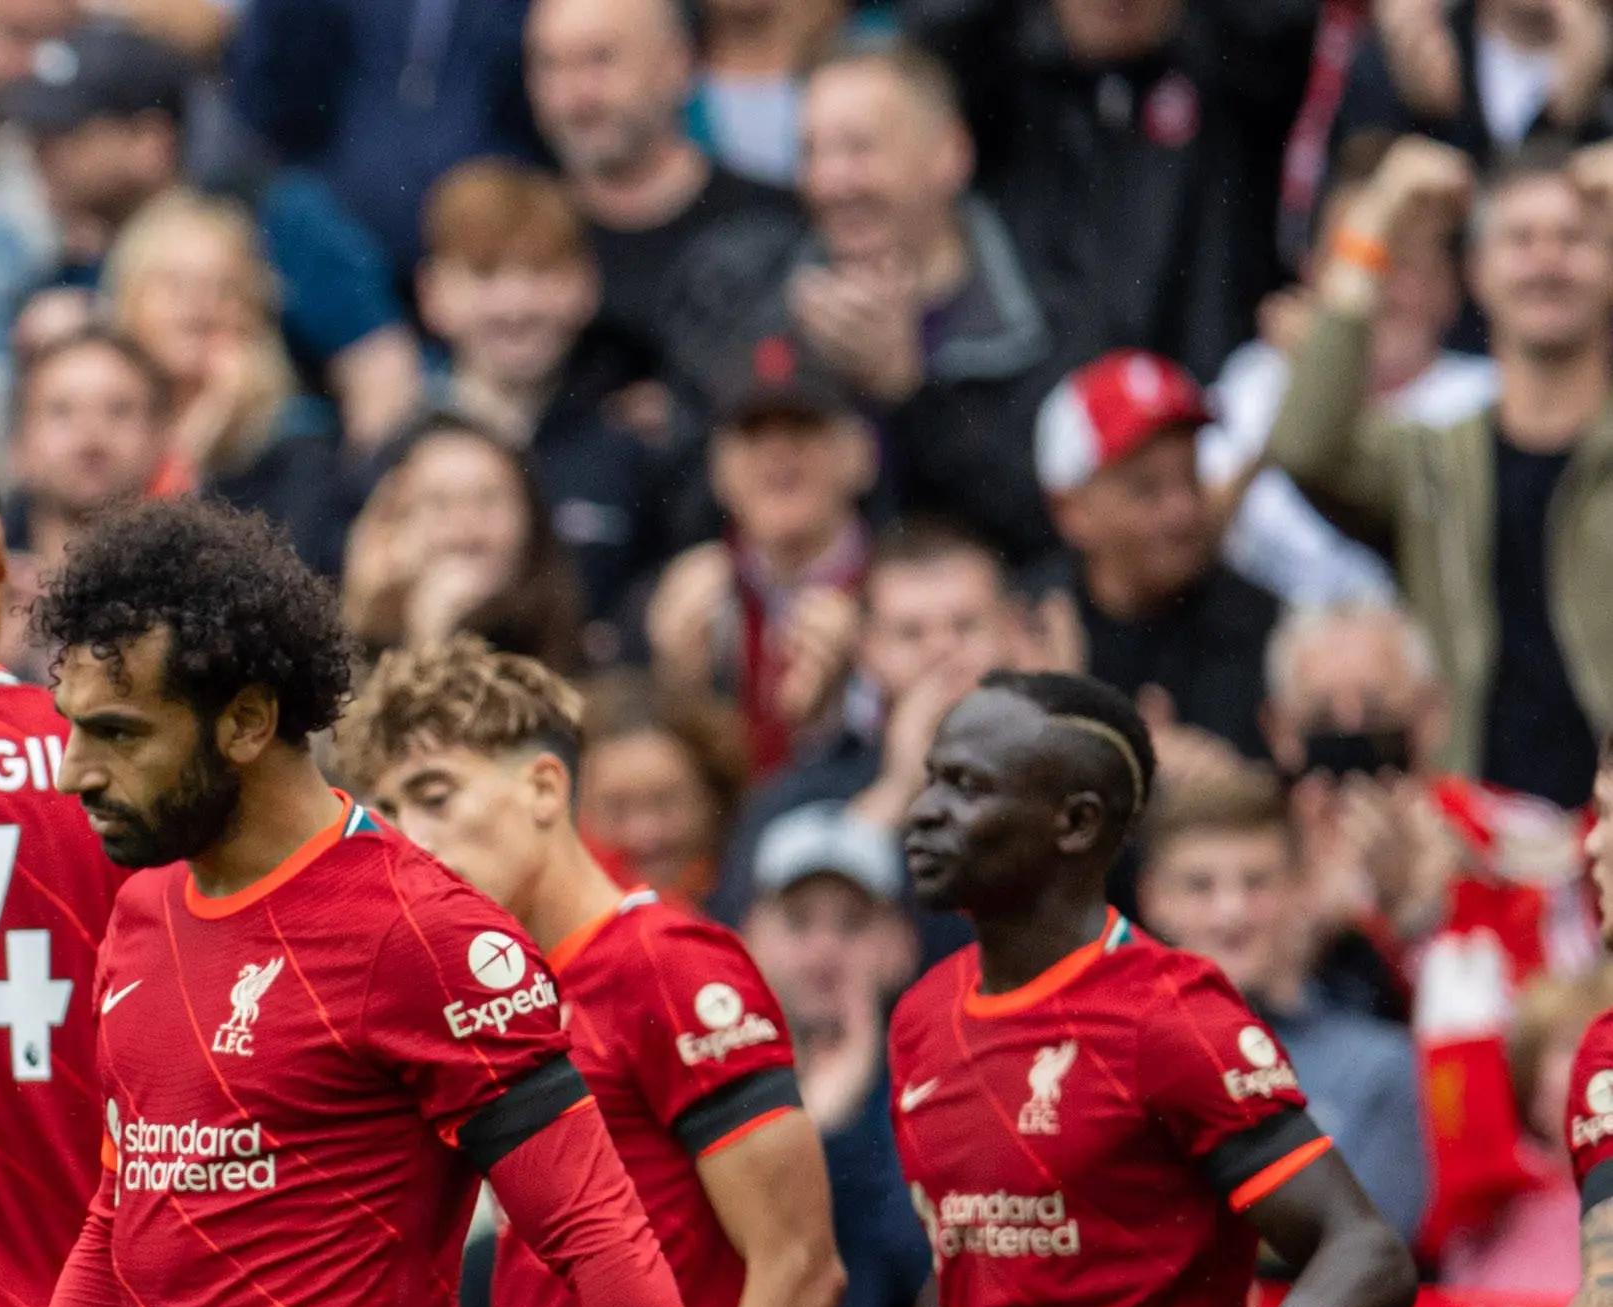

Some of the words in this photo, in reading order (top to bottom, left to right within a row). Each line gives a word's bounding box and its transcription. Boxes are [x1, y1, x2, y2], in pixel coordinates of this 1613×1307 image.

[676, 1012, 779, 1067] Expedia
[125, 1116, 262, 1158] standard
[125, 1153, 276, 1191] chartered
